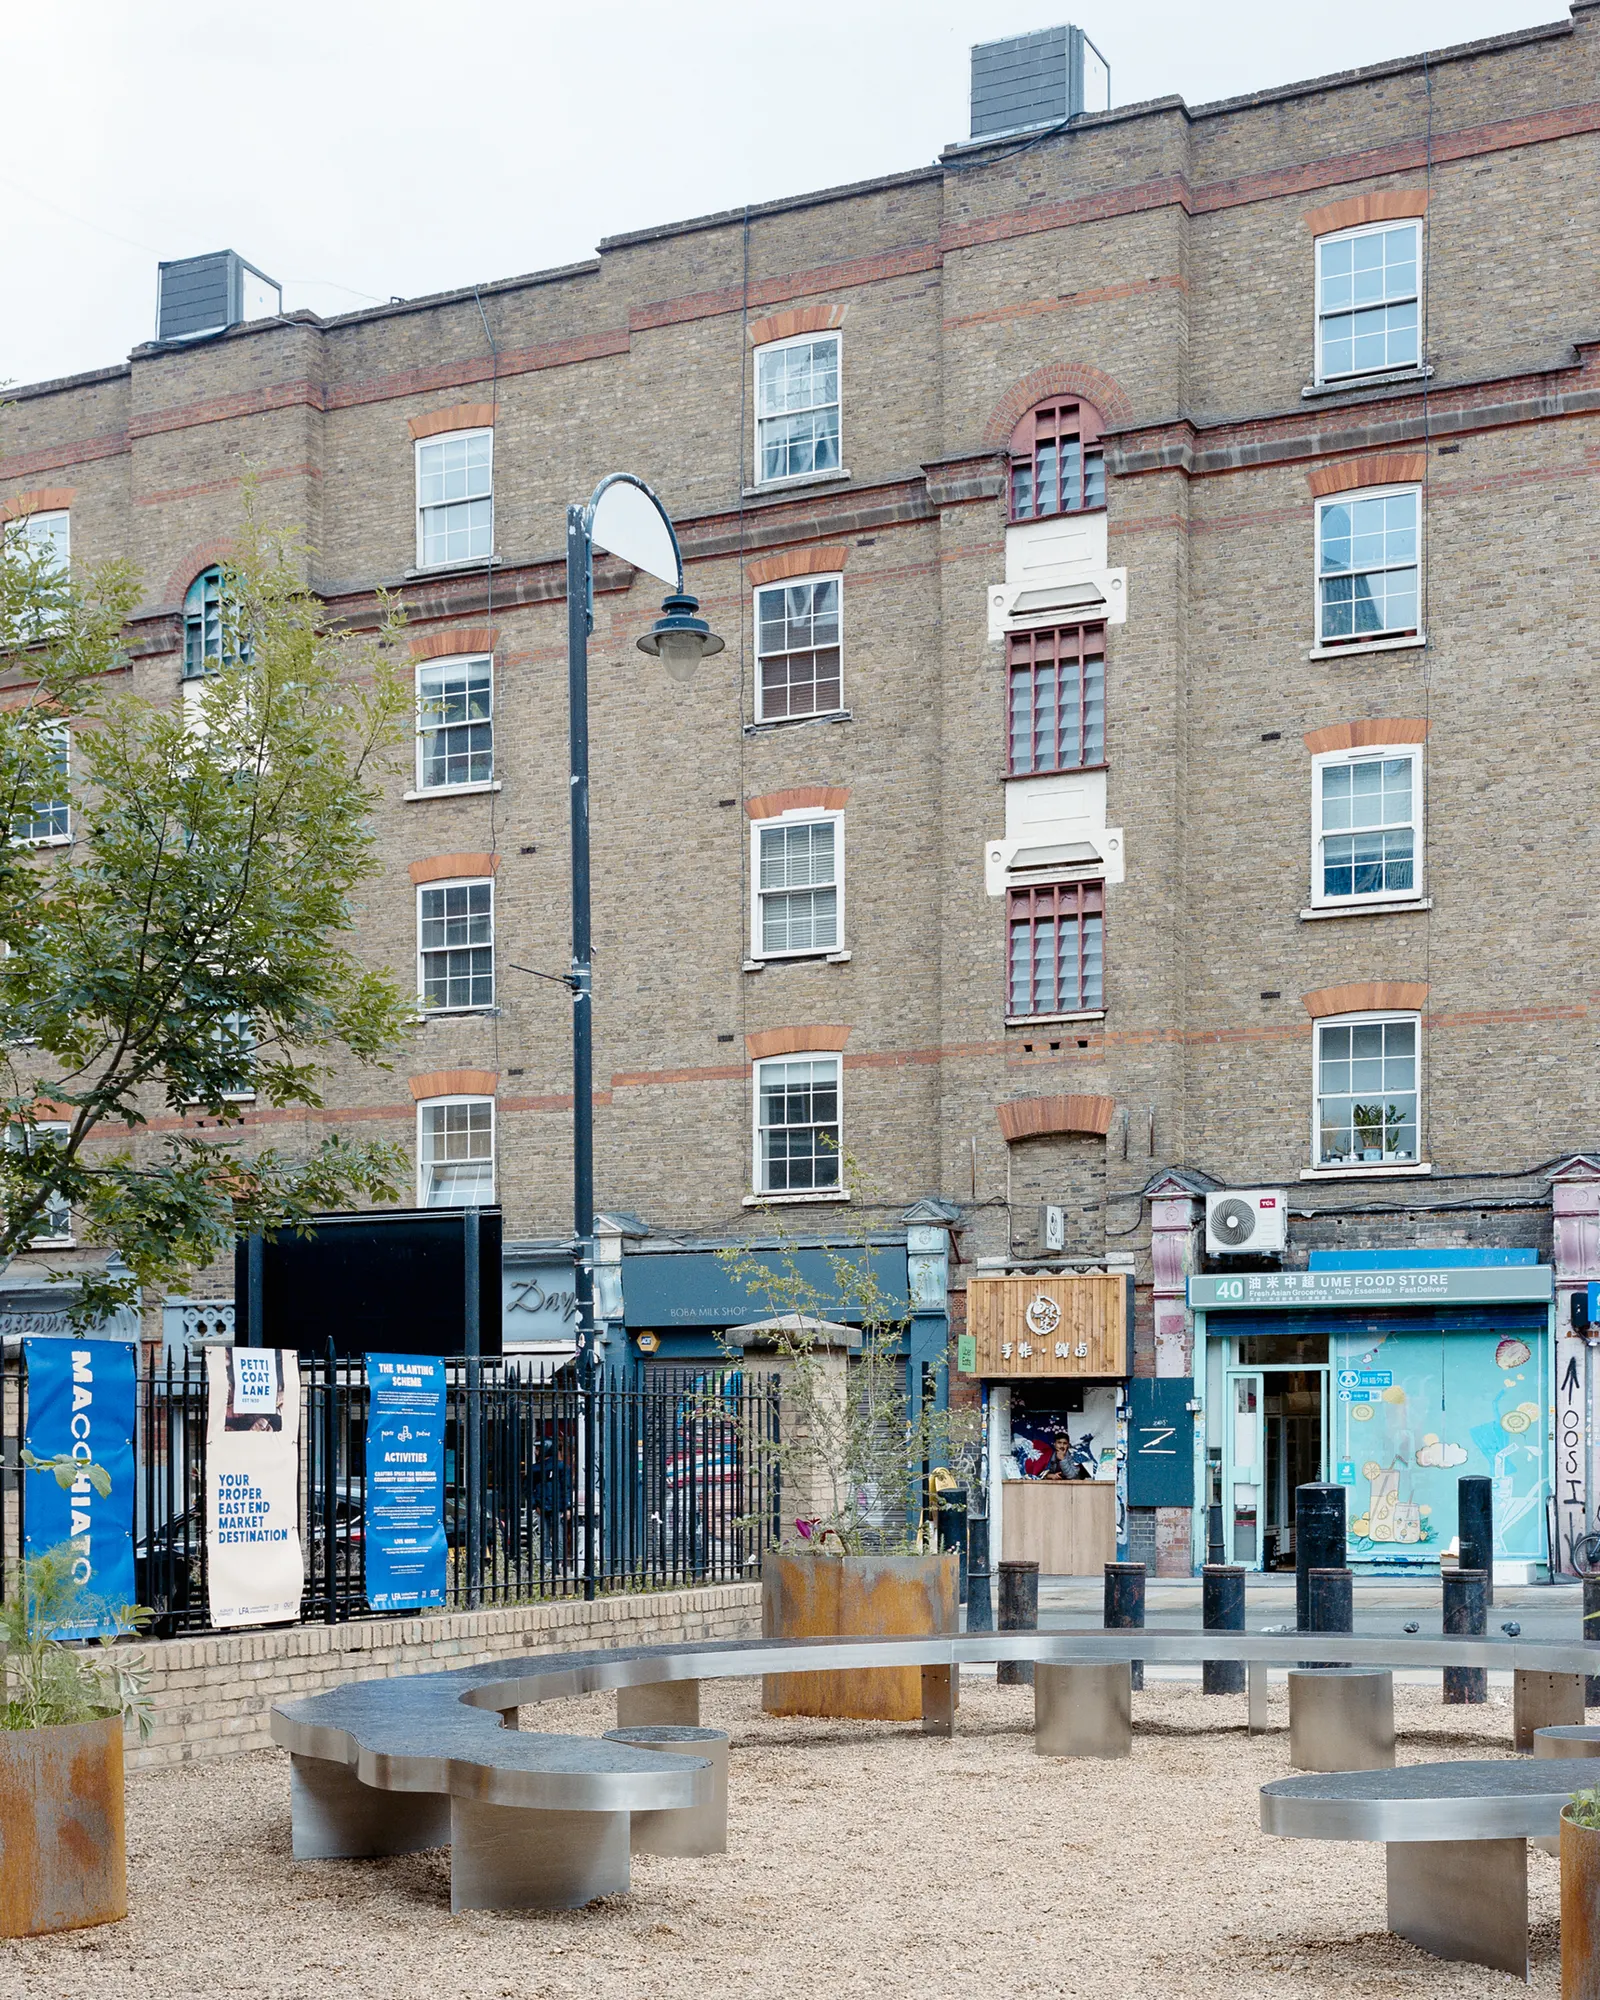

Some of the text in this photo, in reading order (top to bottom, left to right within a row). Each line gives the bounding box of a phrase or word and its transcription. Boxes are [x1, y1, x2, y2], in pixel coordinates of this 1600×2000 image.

[1320, 1276, 1351, 1288] UME
[1355, 1275, 1395, 1287] FOOD
[1399, 1274, 1448, 1286] STORE
[1216, 1280, 1243, 1299] 40
[1249, 1285, 1448, 1297] Fresh Asian Groceries Daily Essentials Fast Delivery
[506, 1279, 576, 1323] Day
[670, 1305, 748, 1317] BOBA MILK SHOP
[240, 1358, 269, 1371] PETTI
[378, 1363, 434, 1376] THE PLANTING
[241, 1371, 270, 1383] COAT
[392, 1376, 422, 1387] SCHEME
[242, 1384, 270, 1396] LANE
[384, 1452, 428, 1463] ACTIVITIES
[219, 1474, 250, 1487] YOUR
[218, 1488, 262, 1501] PROPER
[218, 1501, 271, 1515] EAST END
[218, 1515, 265, 1529] MARKET
[218, 1528, 288, 1544] DESTINATION
[238, 1606, 249, 1615] LFA
